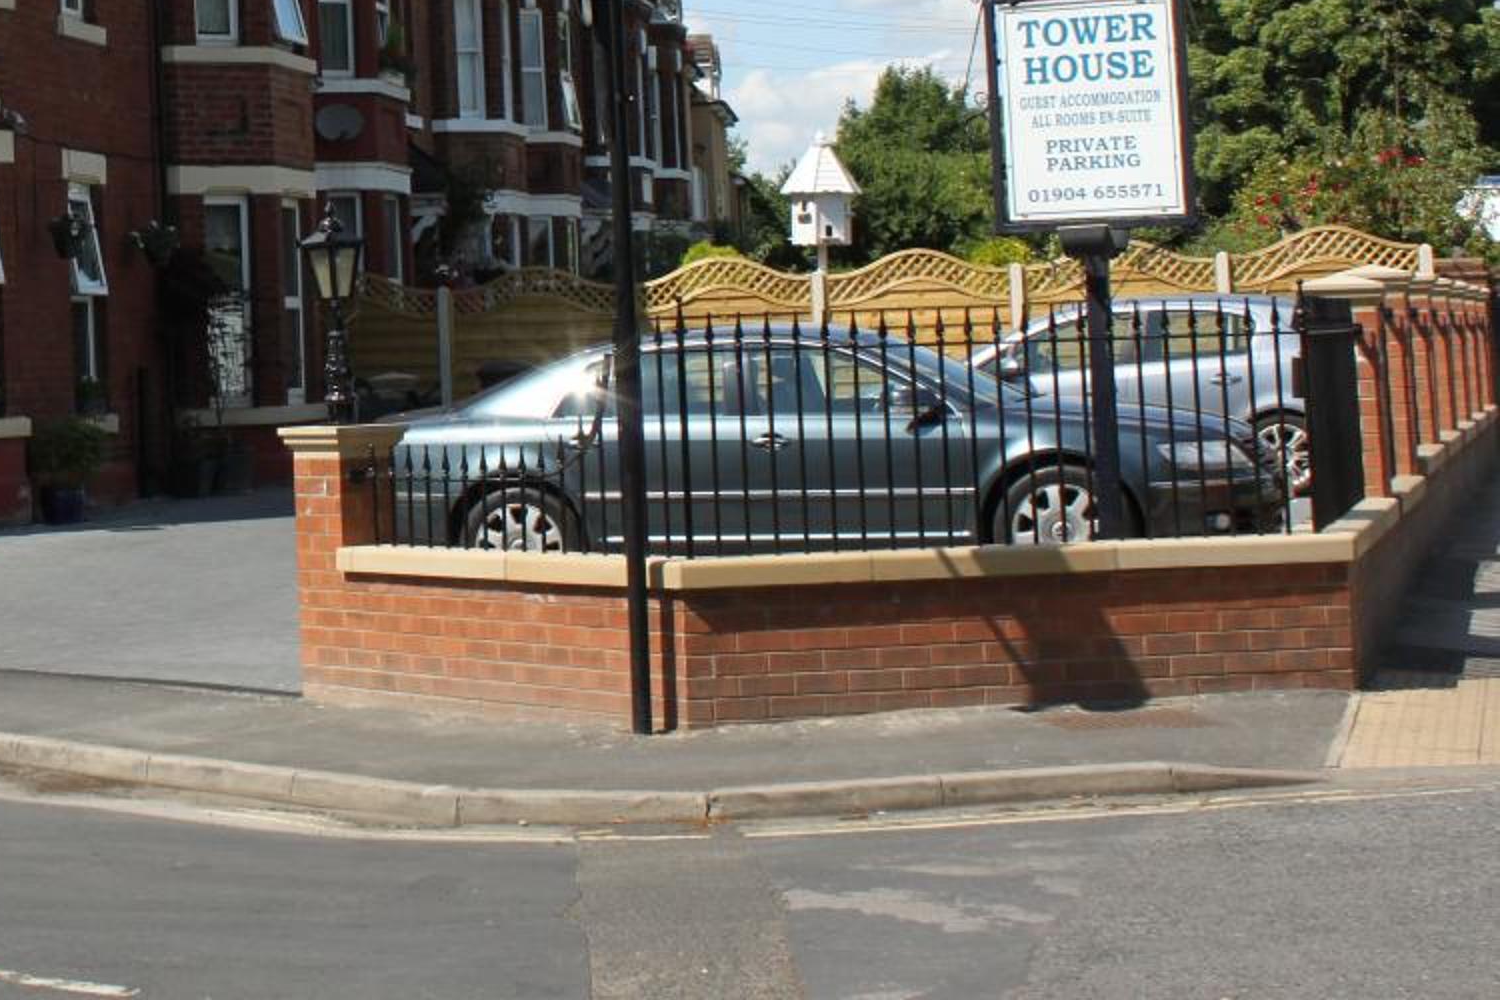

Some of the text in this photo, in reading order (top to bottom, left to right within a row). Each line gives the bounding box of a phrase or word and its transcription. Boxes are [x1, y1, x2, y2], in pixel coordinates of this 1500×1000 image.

[1017, 13, 1156, 48] TOWER
[1023, 50, 1154, 84] HOUSE
[1020, 89, 1160, 110] GUEST ACCOMMODATION
[1032, 114, 1052, 128] ALL
[1055, 111, 1095, 126] ROOMS
[1046, 136, 1137, 154] PRIVATE
[1046, 153, 1140, 171] PARKING
[1028, 183, 1162, 202] 01904 655571
